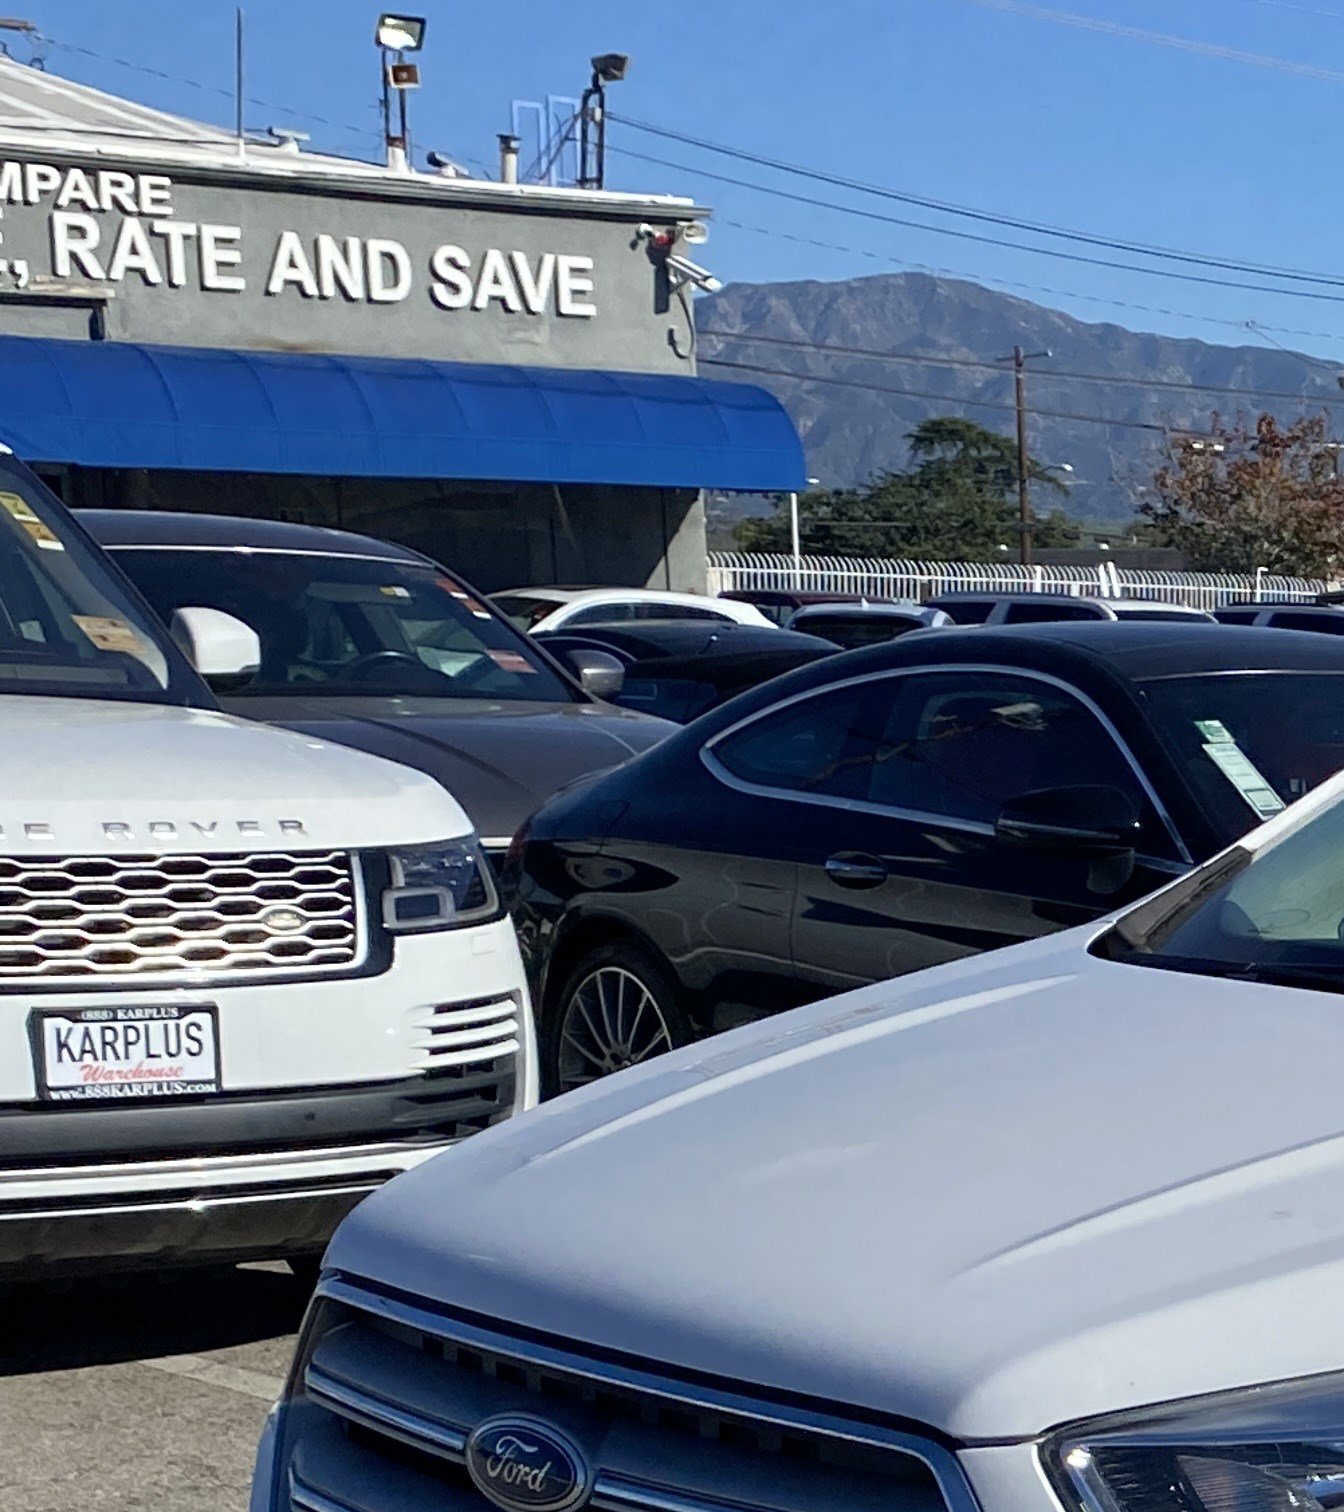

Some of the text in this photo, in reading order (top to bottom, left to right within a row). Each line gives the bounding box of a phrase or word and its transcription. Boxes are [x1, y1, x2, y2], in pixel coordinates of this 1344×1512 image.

[52, 210, 246, 290] RATE
[267, 230, 413, 302] AND
[431, 245, 597, 317] SAVE
[117, 1007, 179, 1020] KARPLUS
[55, 1021, 204, 1063] KARPLUS
[79, 1060, 184, 1083] Warehouse
[486, 1435, 552, 1493] Ford
